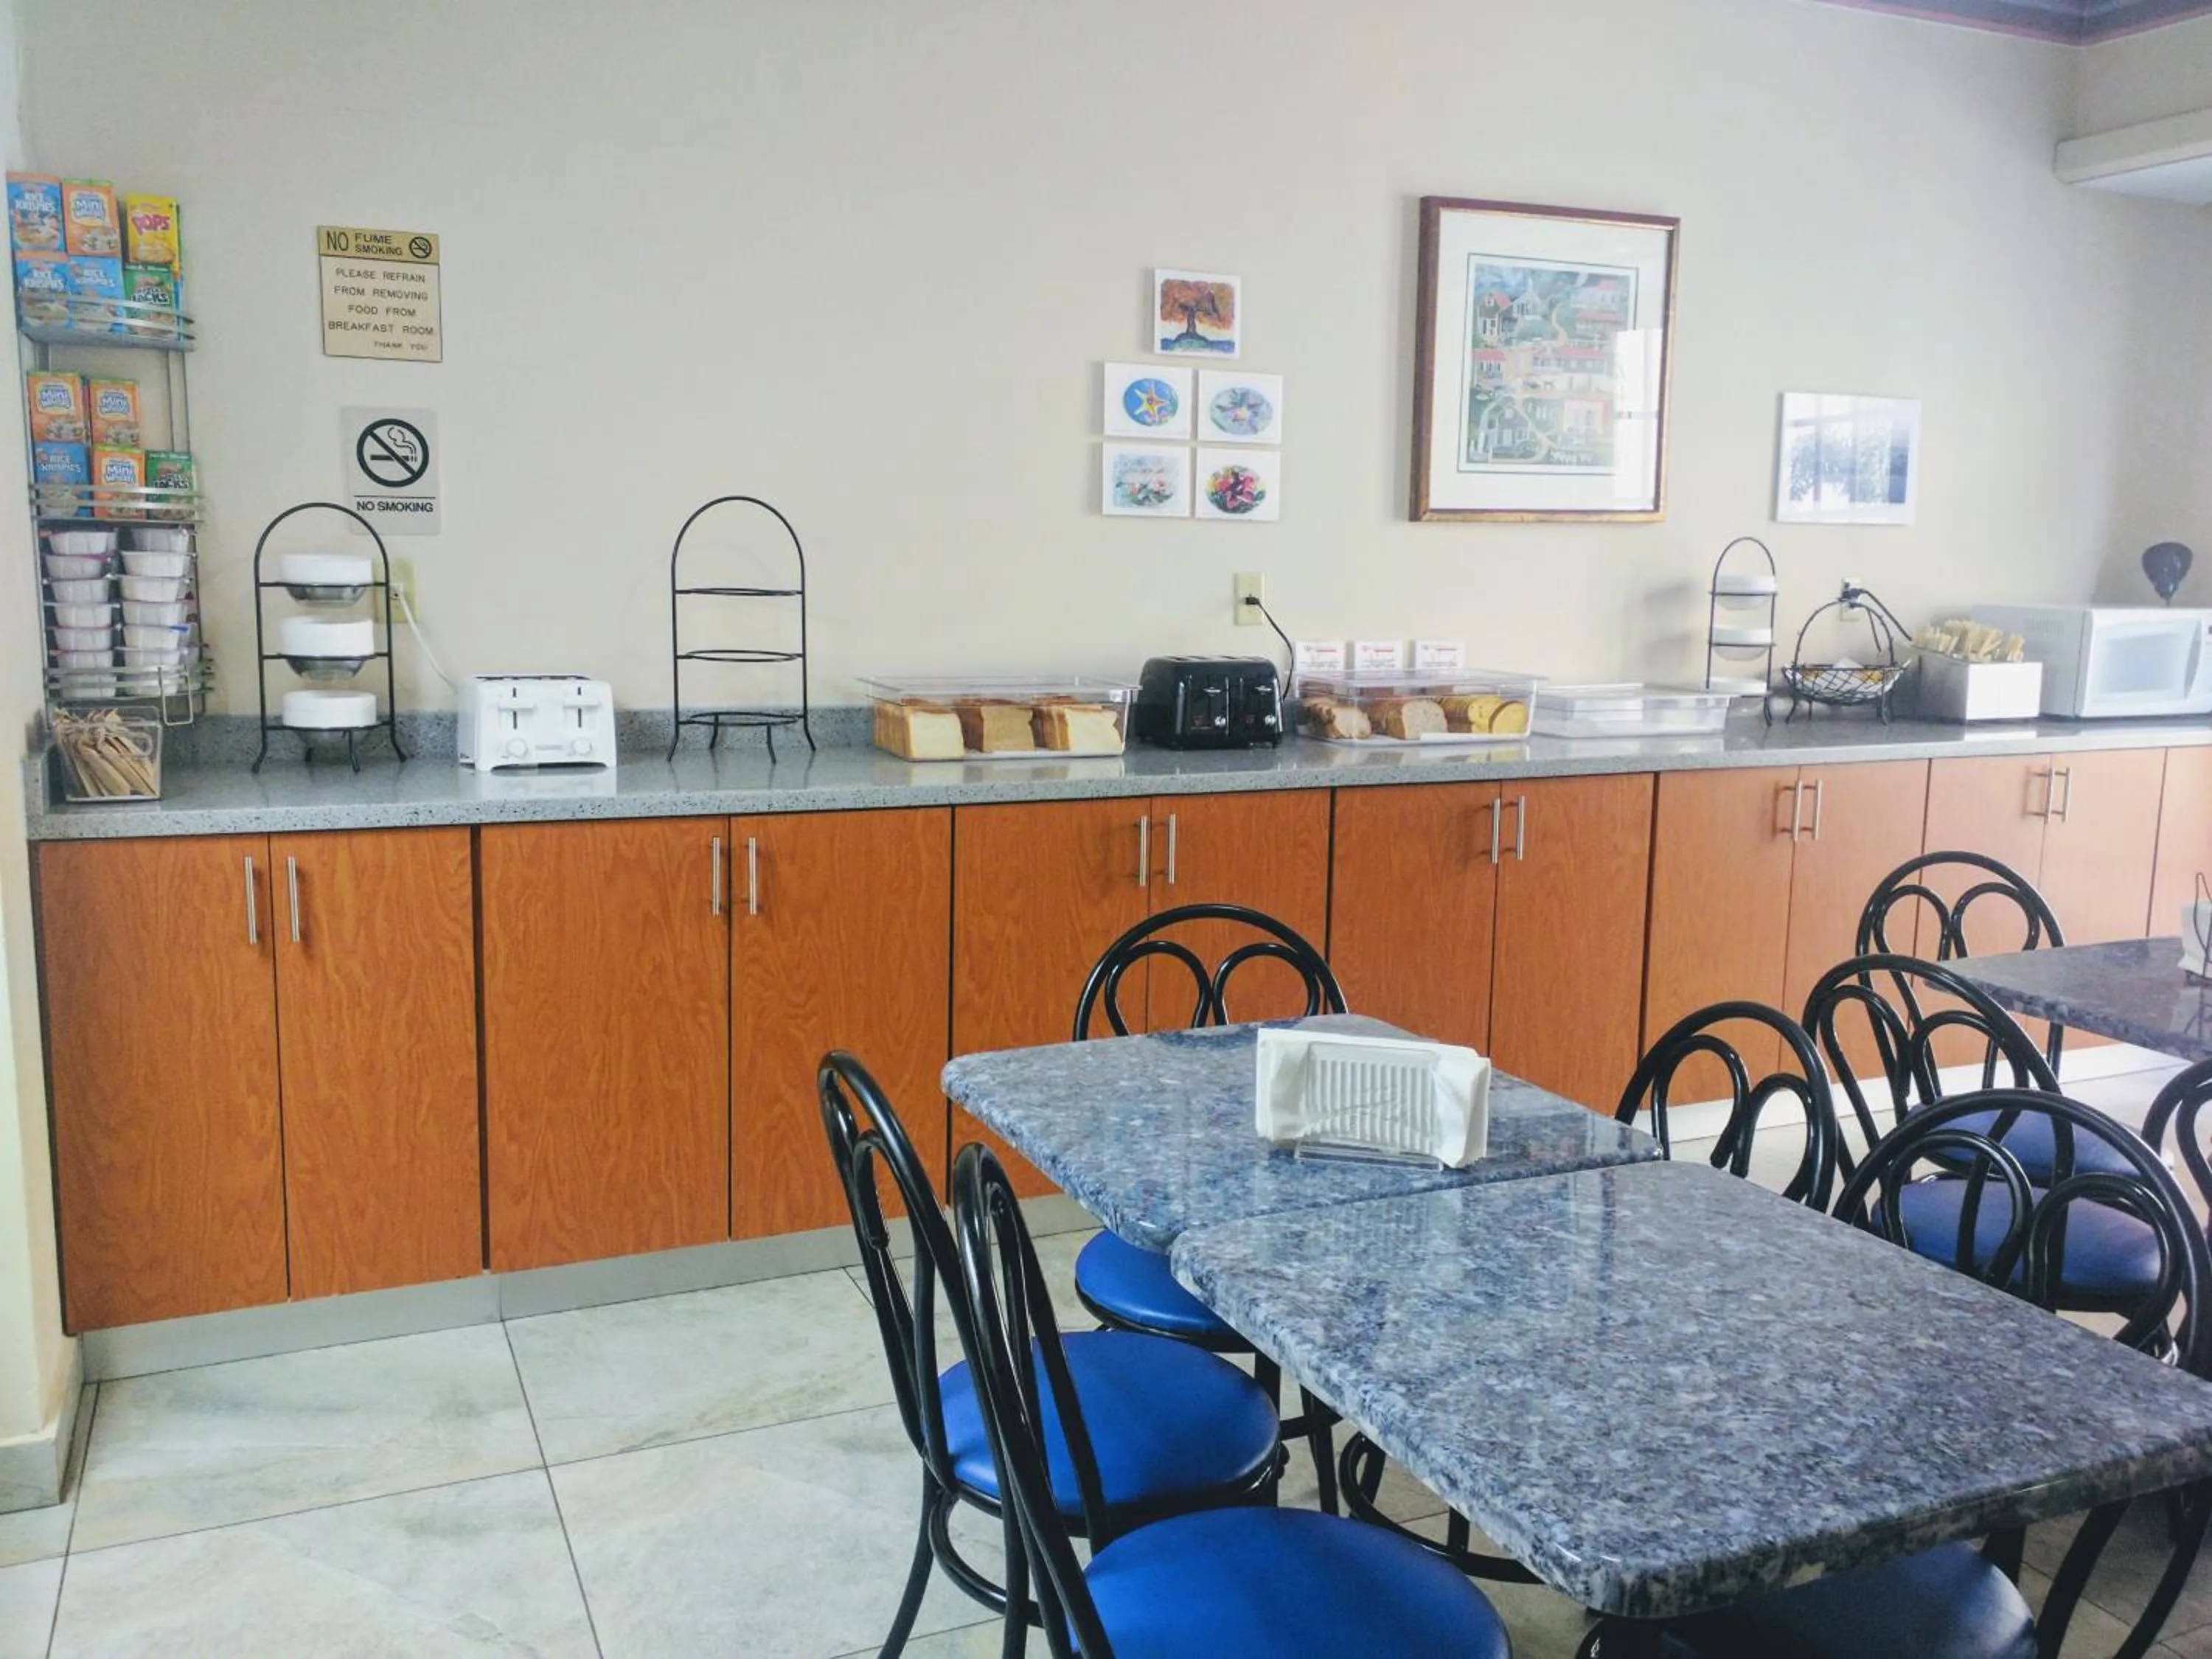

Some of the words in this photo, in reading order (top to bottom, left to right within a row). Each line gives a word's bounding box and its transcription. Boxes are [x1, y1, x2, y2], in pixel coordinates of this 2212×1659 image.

[327, 230, 349, 251] NO
[355, 232, 392, 244] FUME
[355, 245, 403, 256] SMOKING
[335, 268, 376, 279] PLEASE
[383, 271, 425, 283] REFRAIN
[334, 285, 365, 296] FROM
[372, 288, 428, 301] REMOVING
[348, 305, 378, 315] FOOD
[386, 307, 416, 316] FROM
[328, 321, 394, 333] BREAKFAST
[403, 325, 434, 335] ROOM
[357, 501, 375, 511] NO
[378, 501, 434, 512] SMOKING
